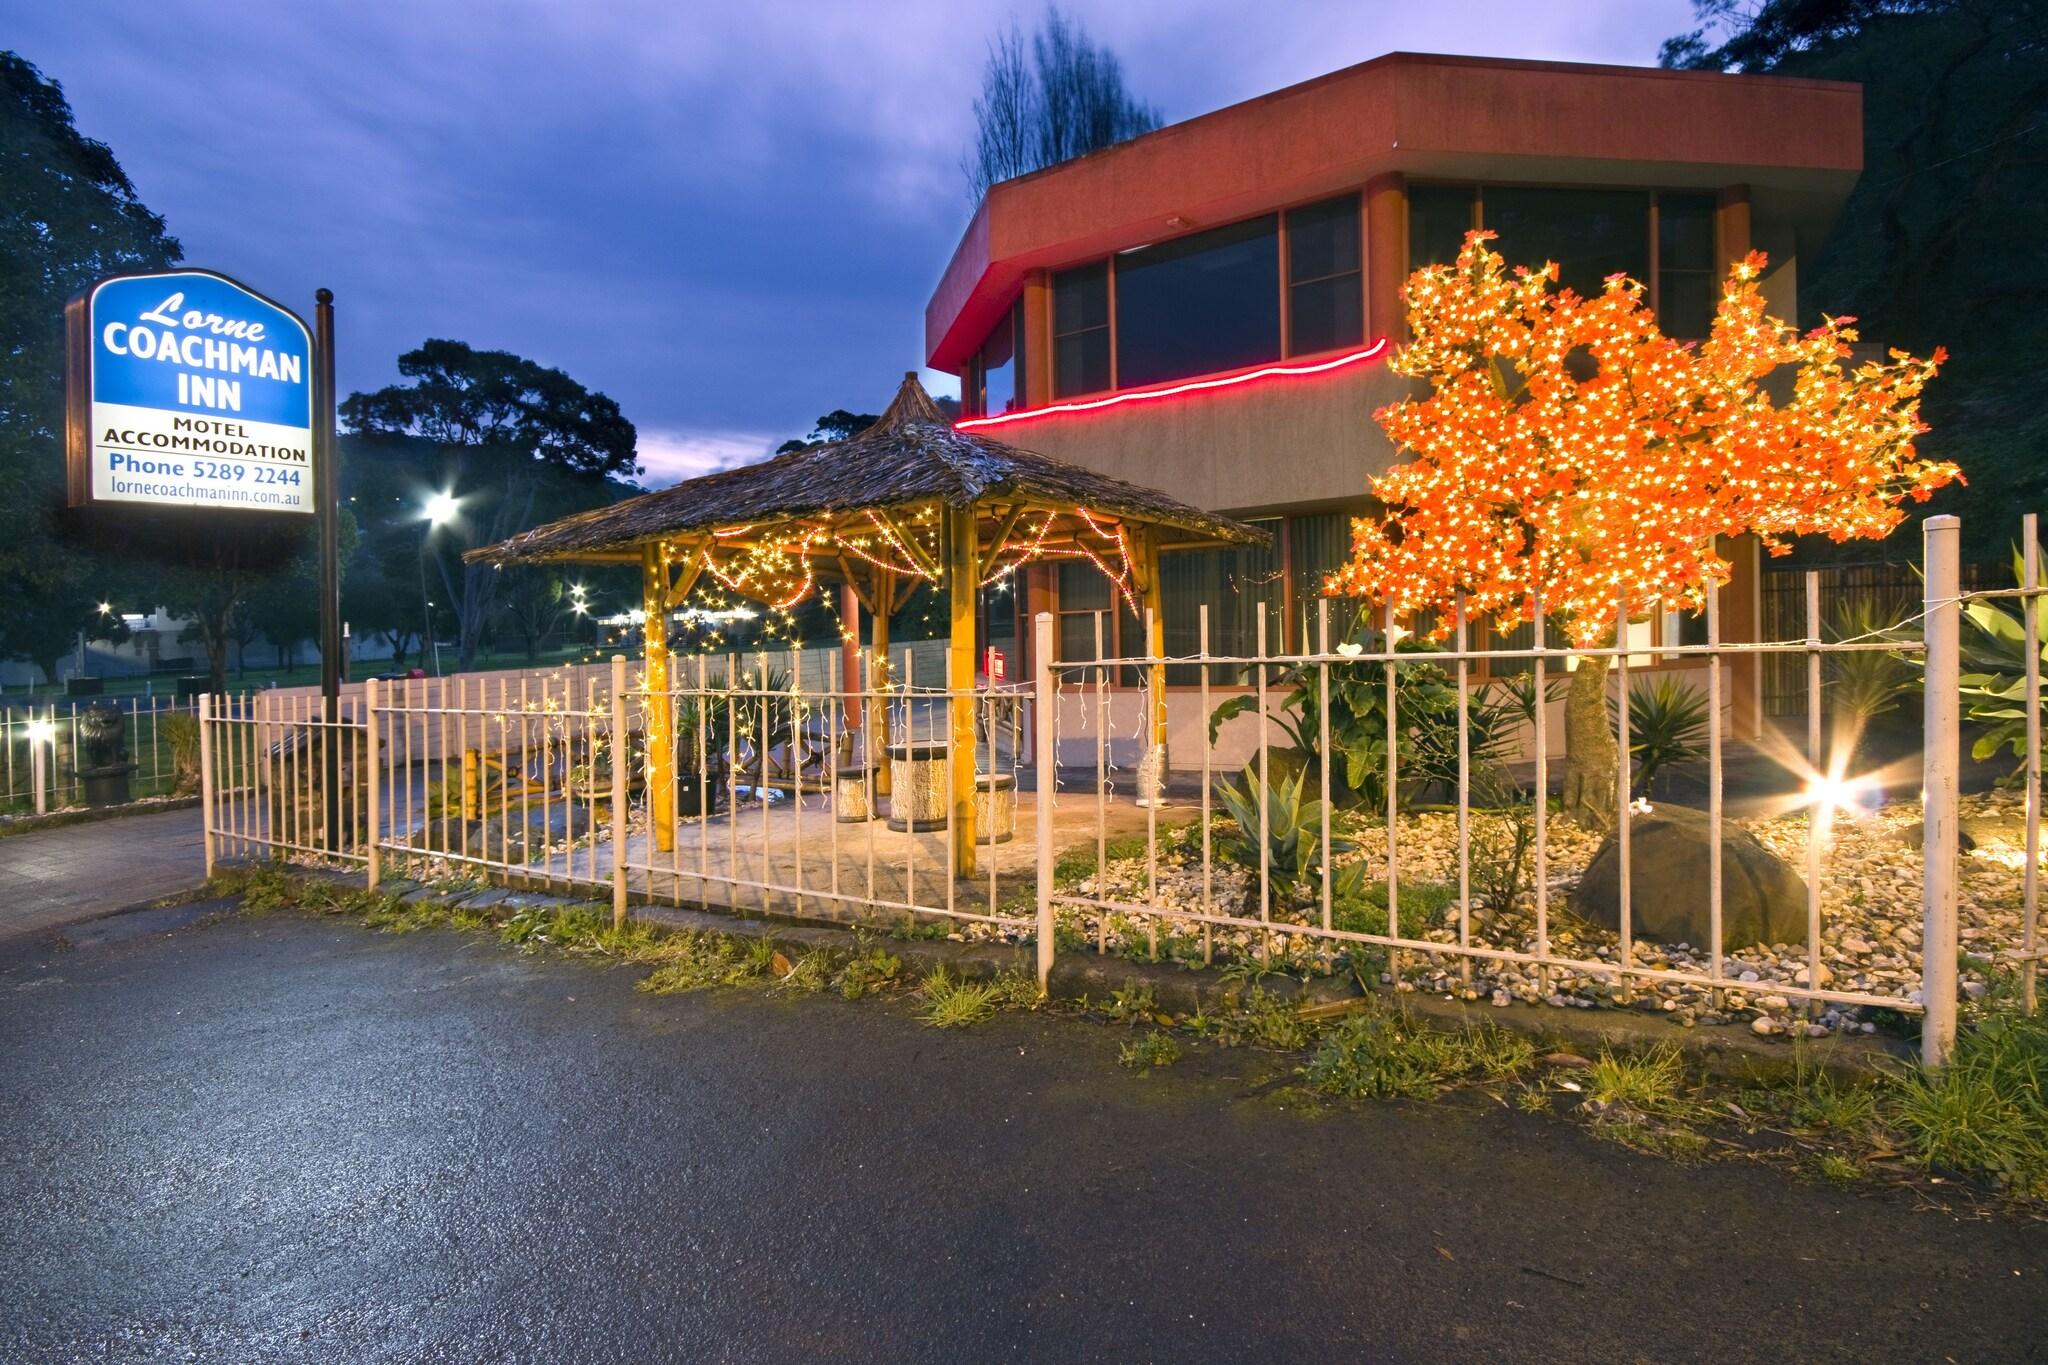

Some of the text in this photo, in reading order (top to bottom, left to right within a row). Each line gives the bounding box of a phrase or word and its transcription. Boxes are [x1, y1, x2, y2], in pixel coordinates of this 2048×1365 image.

[139, 292, 265, 342] Lorne
[103, 322, 300, 383] COACHMAN
[178, 373, 240, 411] INN
[173, 417, 249, 438] MOTEL
[104, 429, 306, 462] ACCOMMODATION
[110, 453, 300, 486] Phone 5289 2244
[112, 477, 300, 505] lornecoachmaninn.com.au
